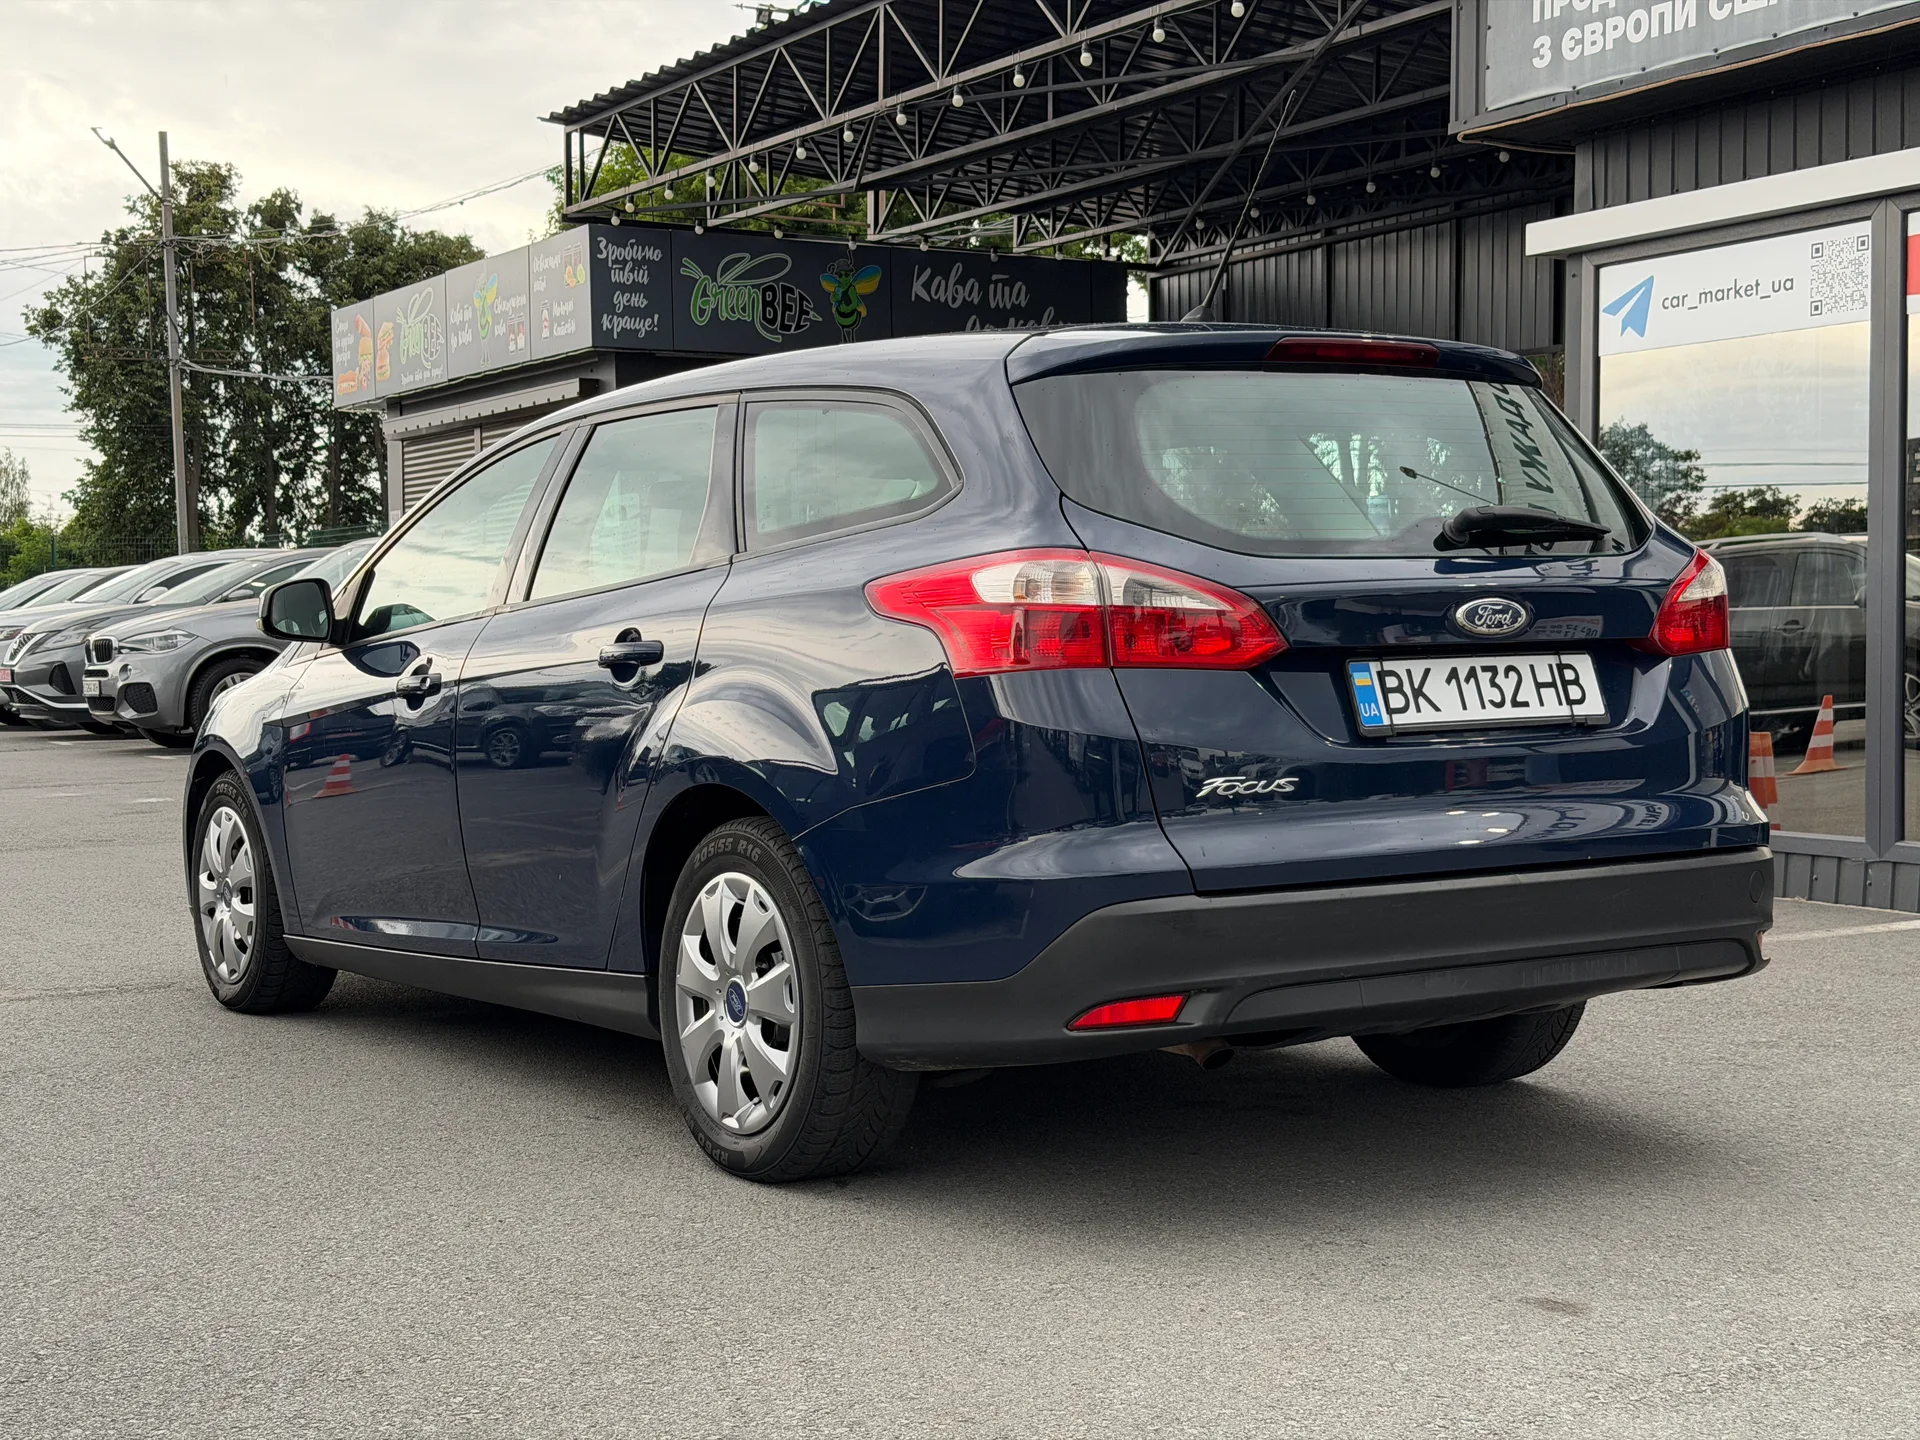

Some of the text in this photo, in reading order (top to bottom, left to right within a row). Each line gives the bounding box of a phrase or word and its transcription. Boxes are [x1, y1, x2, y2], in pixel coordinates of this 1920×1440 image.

[1532, 35, 1552, 69] З
[1561, 0, 1697, 61] ЄВРОПИ
[597, 236, 663, 268] Зробимо
[610, 261, 650, 286] твій
[911, 262, 1030, 309] Кава та
[613, 290, 648, 313] день
[1661, 277, 1795, 311] car_market_ua
[601, 313, 660, 340] краще!
[1474, 604, 1513, 626] Ford
[1376, 663, 1586, 715] BK 1132 HB
[1360, 702, 1380, 718] UA
[737, 839, 761, 862] R16
